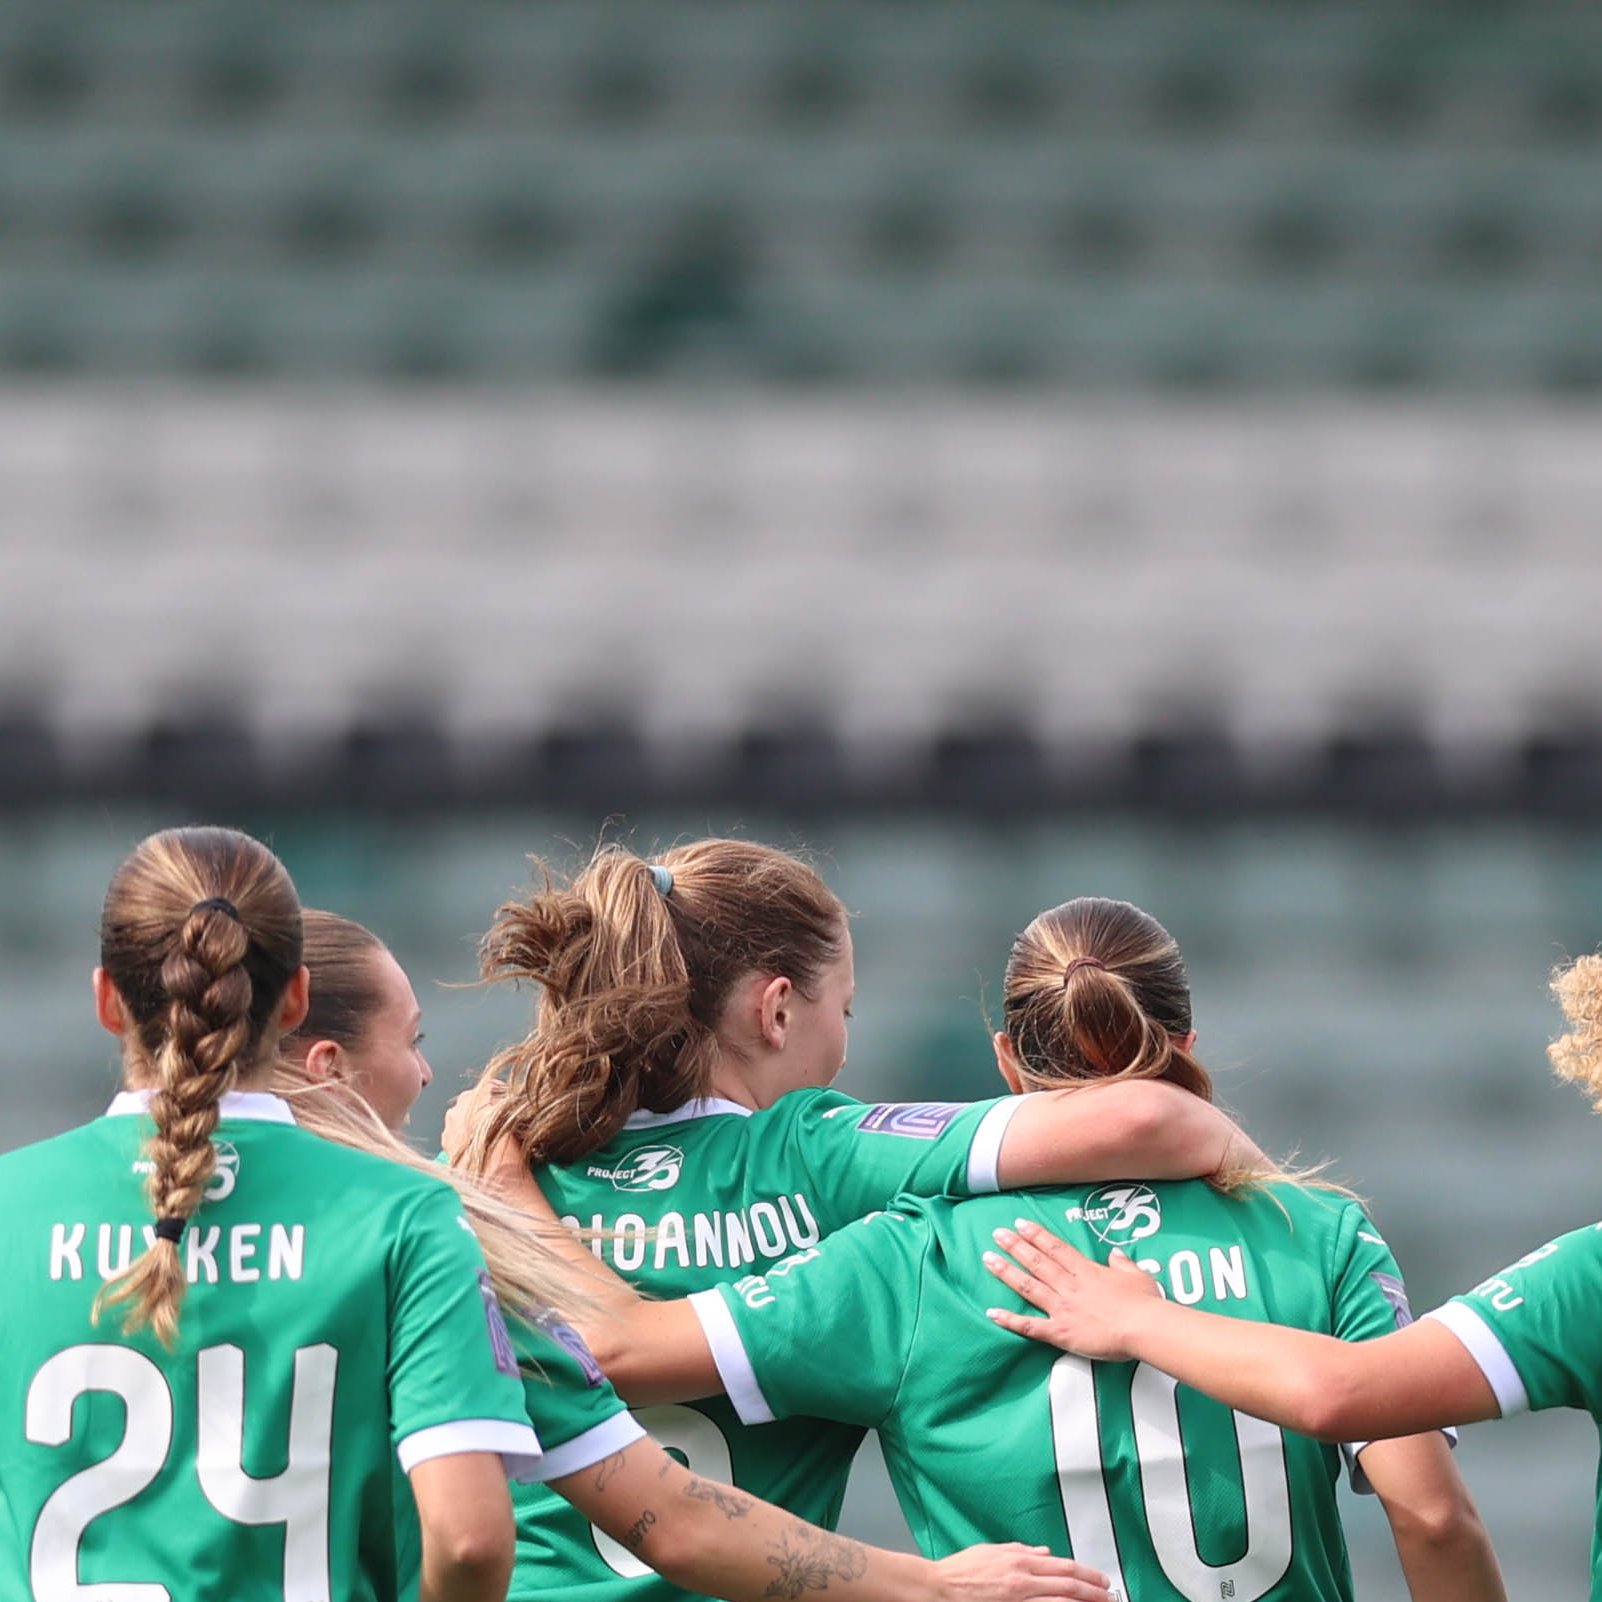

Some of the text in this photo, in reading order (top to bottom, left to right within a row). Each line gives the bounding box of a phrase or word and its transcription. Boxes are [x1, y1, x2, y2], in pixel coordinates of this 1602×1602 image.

[203, 1152, 239, 1201] 5
[586, 1150, 681, 1190] PROJECT 35
[559, 1193, 820, 1272] IOANNOU
[1064, 1187, 1161, 1239] PRJECT 35
